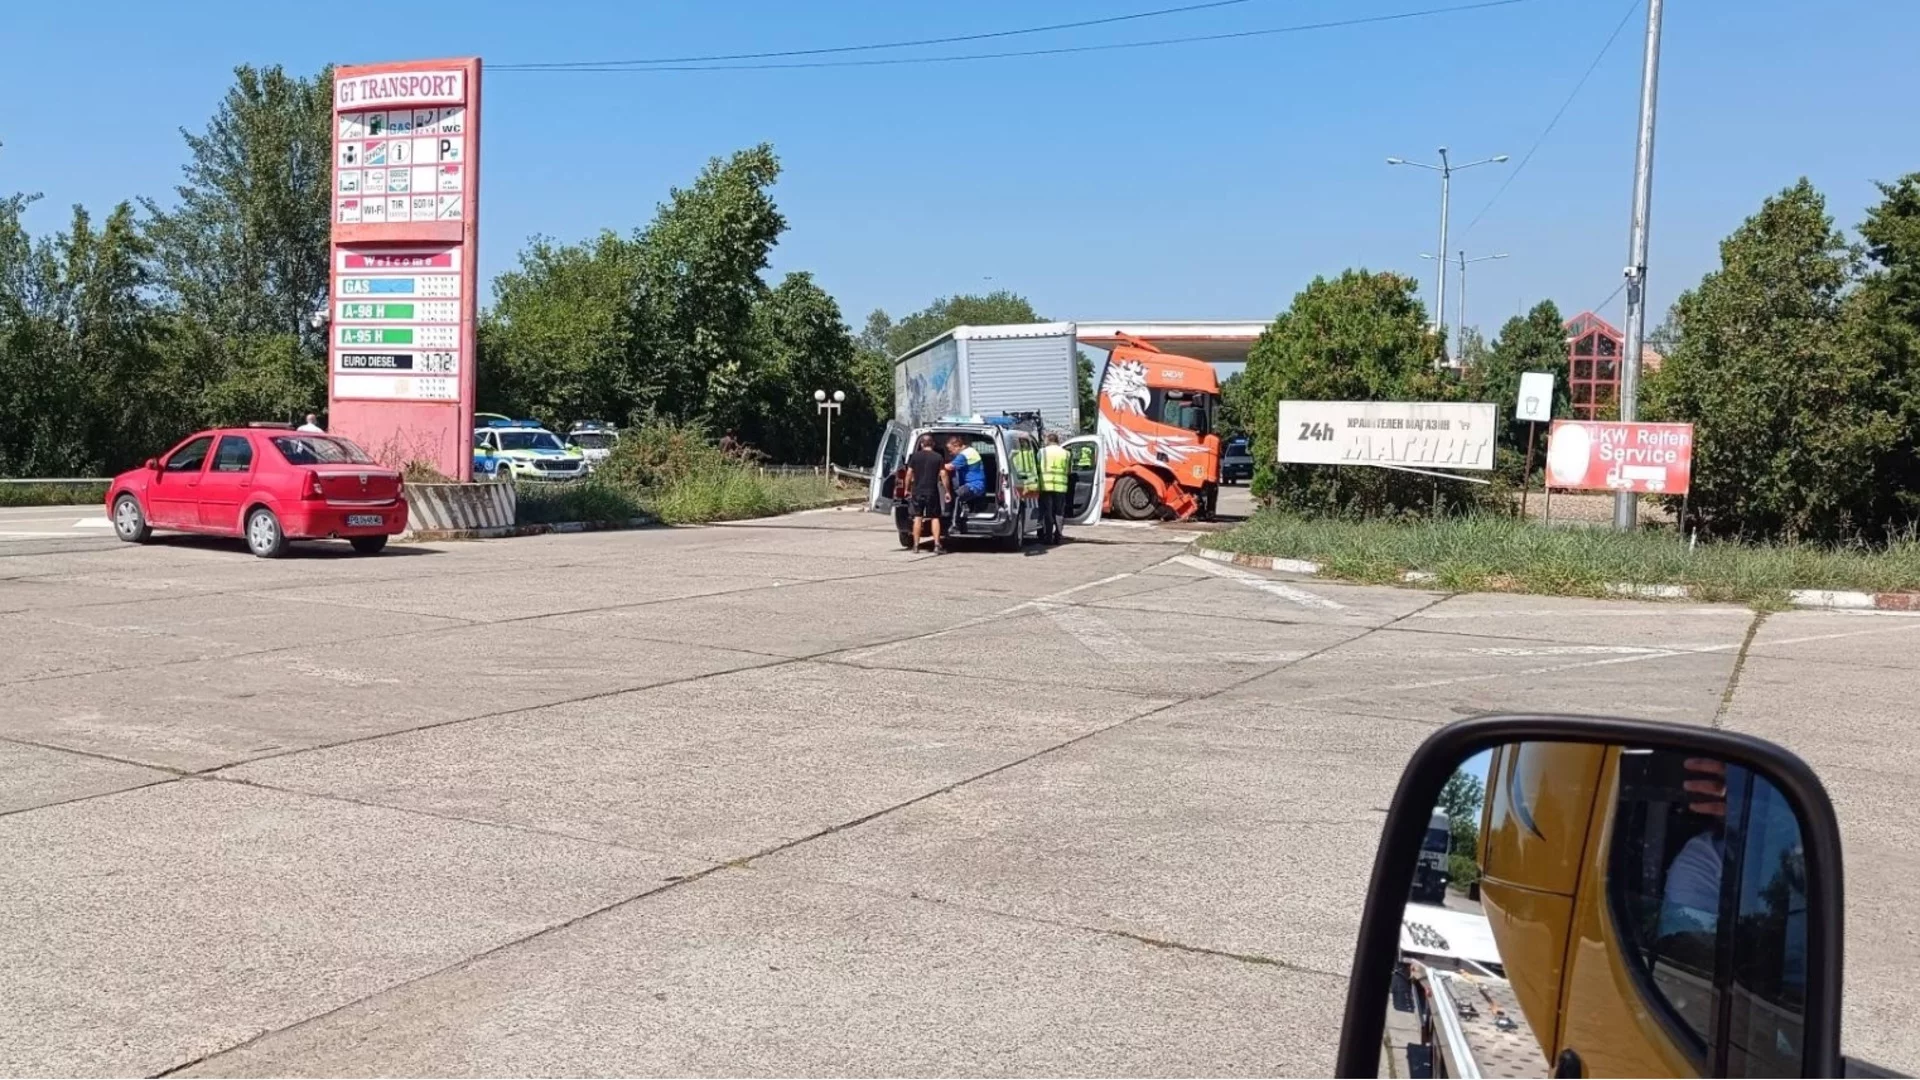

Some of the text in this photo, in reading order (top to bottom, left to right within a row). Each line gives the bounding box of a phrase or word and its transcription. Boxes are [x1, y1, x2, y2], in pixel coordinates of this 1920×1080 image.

[340, 75, 457, 103] GT TRANSPORT
[389, 121, 411, 135] GAS
[442, 124, 461, 133] WC
[440, 139, 451, 161] P
[392, 200, 404, 209] TIR
[363, 256, 433, 267] Welcome
[344, 279, 370, 293] GAS
[344, 304, 385, 318] A-98 H
[343, 329, 384, 343] A-95 H
[343, 355, 398, 368] EURO DIESEL
[1298, 421, 1335, 442] 24h
[1588, 425, 1689, 447] LKW Reifen
[1599, 443, 1677, 464] Service
